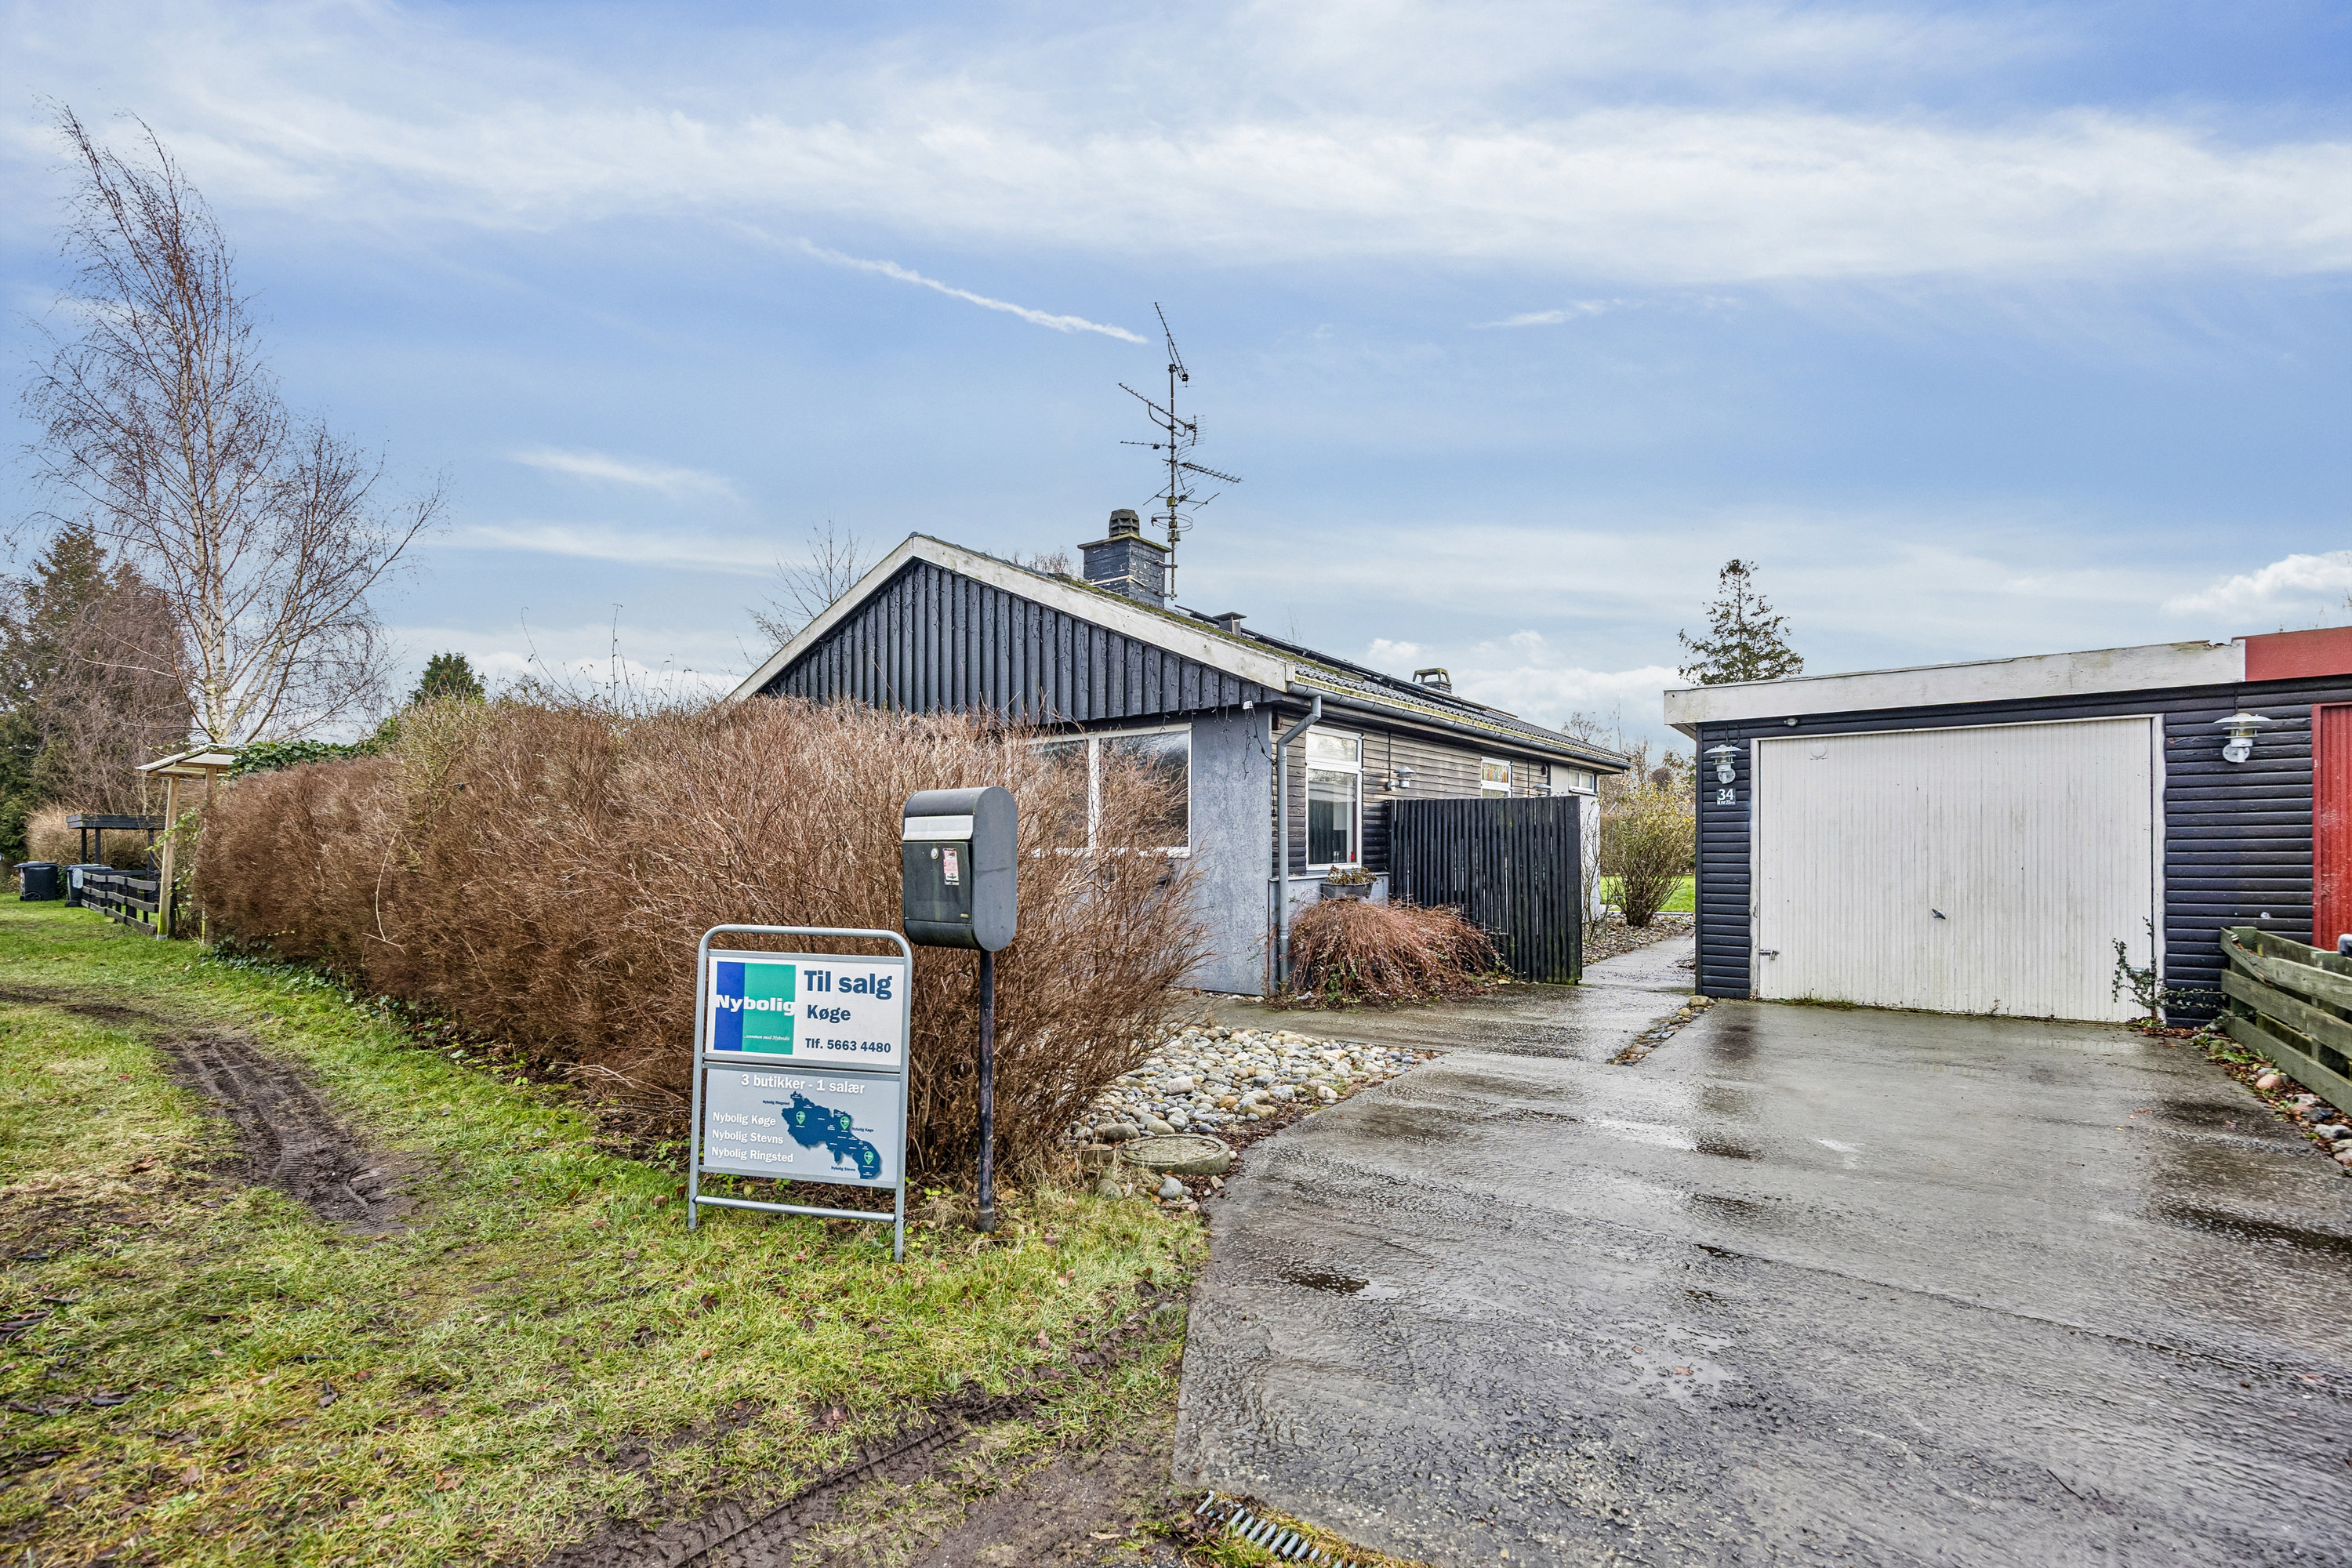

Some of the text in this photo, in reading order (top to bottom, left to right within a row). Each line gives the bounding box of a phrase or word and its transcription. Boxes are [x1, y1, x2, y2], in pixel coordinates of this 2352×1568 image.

[1718, 788, 1733, 800] 34
[804, 970, 892, 1000] Til salg
[715, 994, 796, 1016] Nybolig
[807, 1004, 851, 1023] Køge
[805, 1038, 891, 1053] Tlf. 5663 4480
[741, 1074, 750, 1086] 3
[753, 1075, 806, 1090] butikker
[816, 1079, 826, 1091] 1
[829, 1080, 865, 1094] salær
[713, 1112, 776, 1127] Nybolig Køge
[712, 1129, 784, 1145] Nybolig Stevns
[711, 1146, 793, 1163] Nybolig Ringsted
